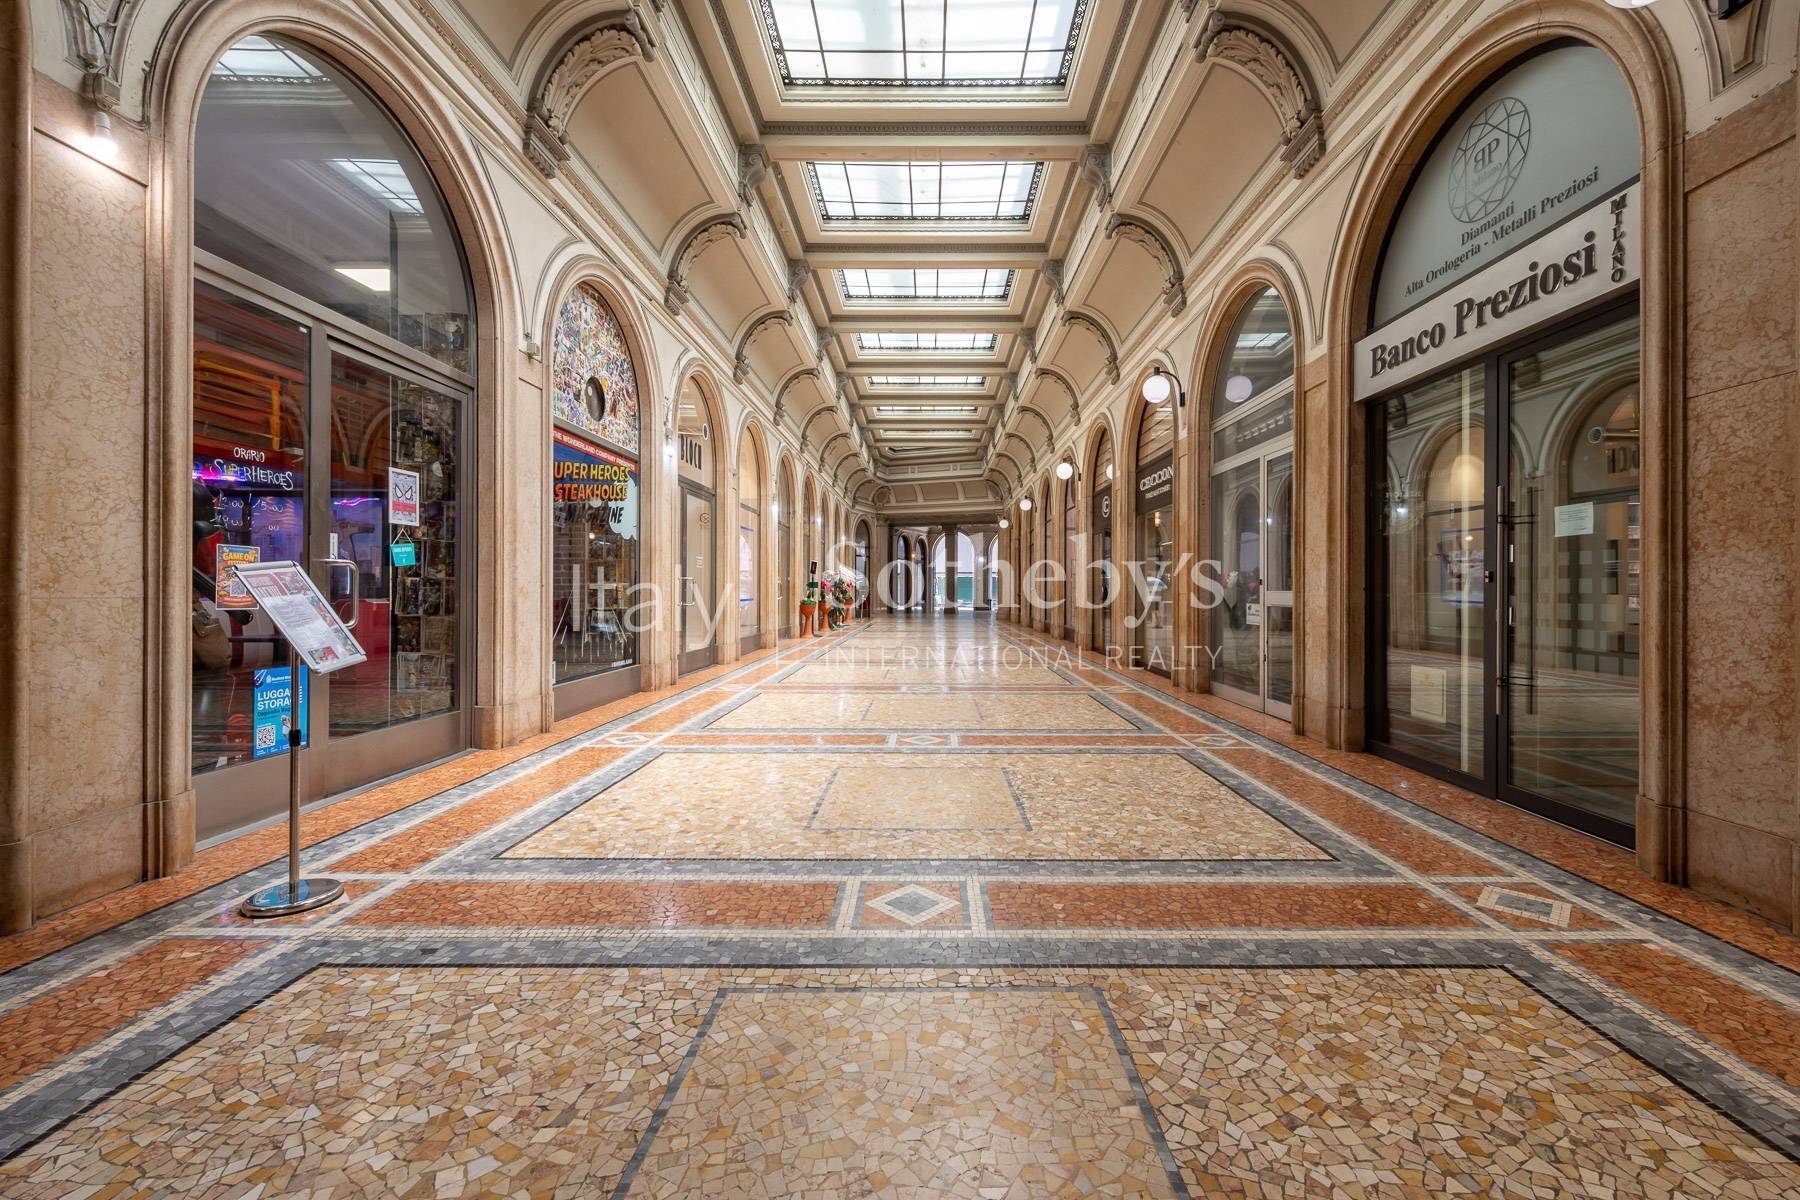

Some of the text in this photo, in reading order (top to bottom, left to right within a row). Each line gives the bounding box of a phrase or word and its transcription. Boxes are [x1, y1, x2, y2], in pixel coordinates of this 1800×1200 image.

[1404, 280, 1425, 298] Alta
[1425, 243, 1481, 284] Orologeria
[1491, 204, 1537, 244] Metalli
[1540, 165, 1600, 215] Preziosi
[1460, 200, 1515, 247] Diamanti
[1610, 192, 1628, 283] MILANO
[1370, 230, 1599, 378] Banco Preziosi
[554, 461, 631, 481] UPER HEROES
[554, 482, 629, 501] STEAKHOUSE
[257, 686, 303, 701] LUGGAE
[257, 694, 303, 711] STORAE
